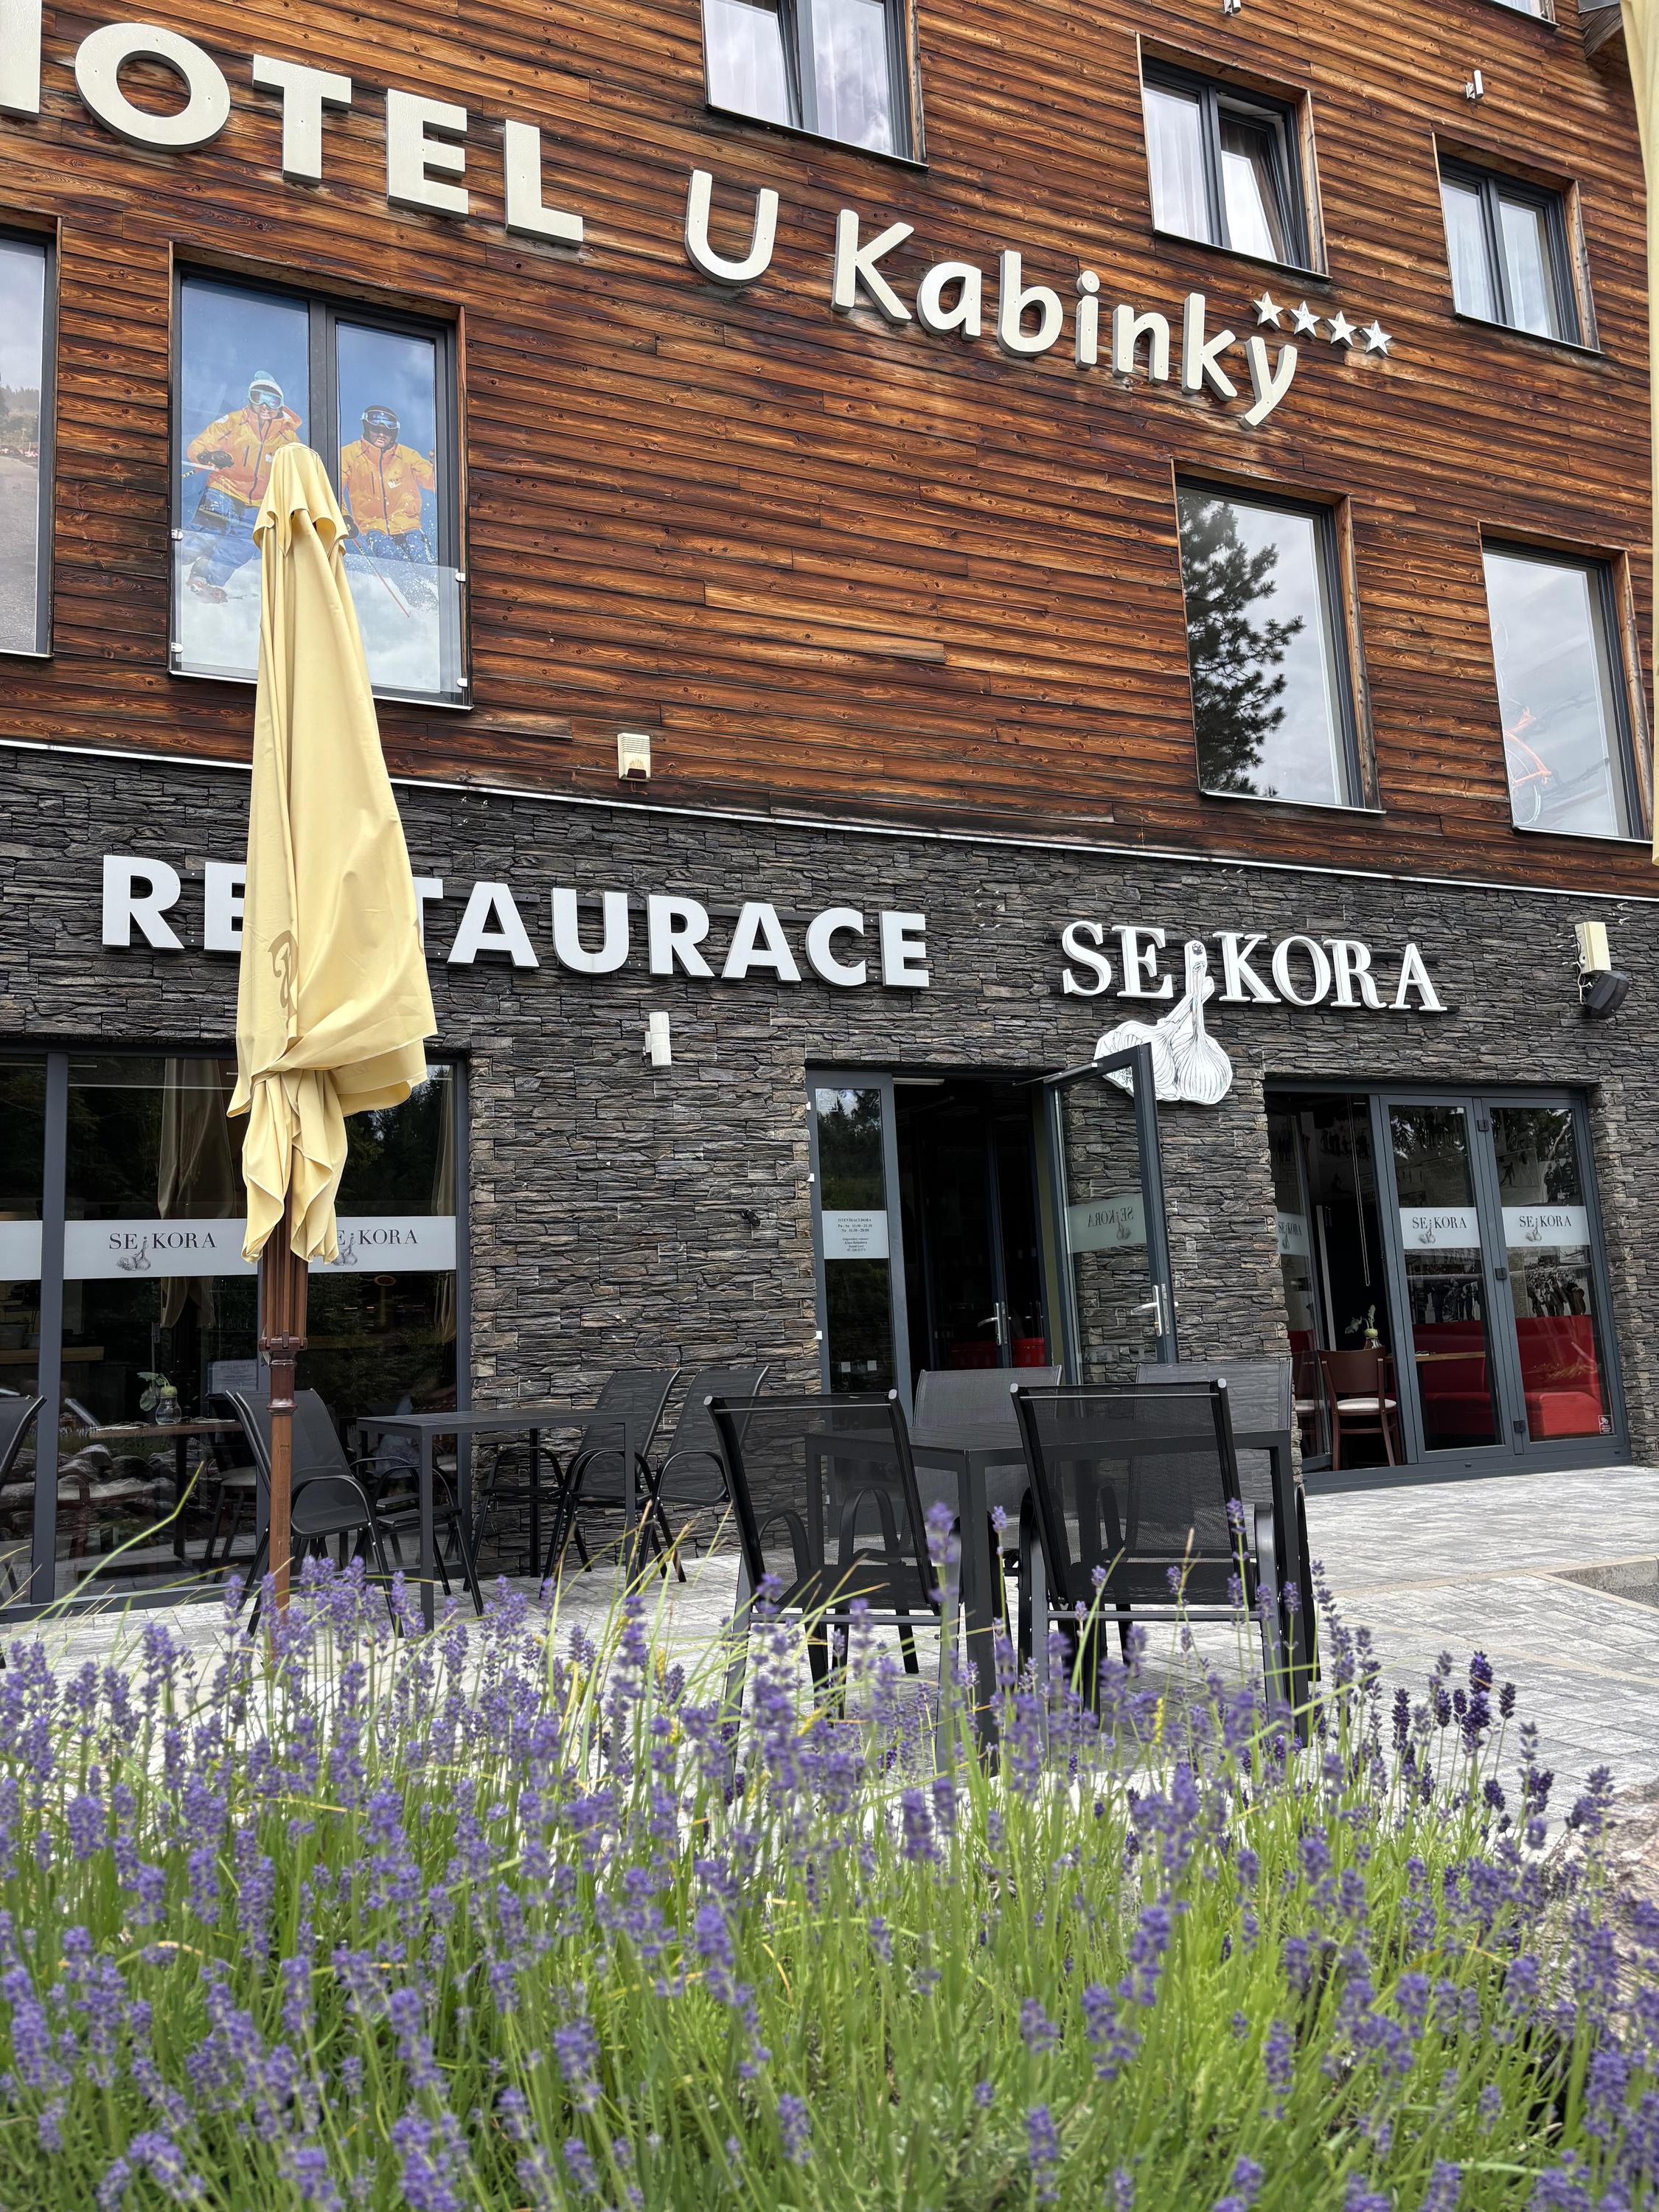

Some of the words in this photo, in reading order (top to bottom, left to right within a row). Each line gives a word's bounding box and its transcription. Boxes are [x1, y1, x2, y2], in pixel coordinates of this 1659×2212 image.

[685, 170, 779, 286] U
[832, 209, 1298, 431] Kabinky
[102, 855, 931, 988] REAURACE
